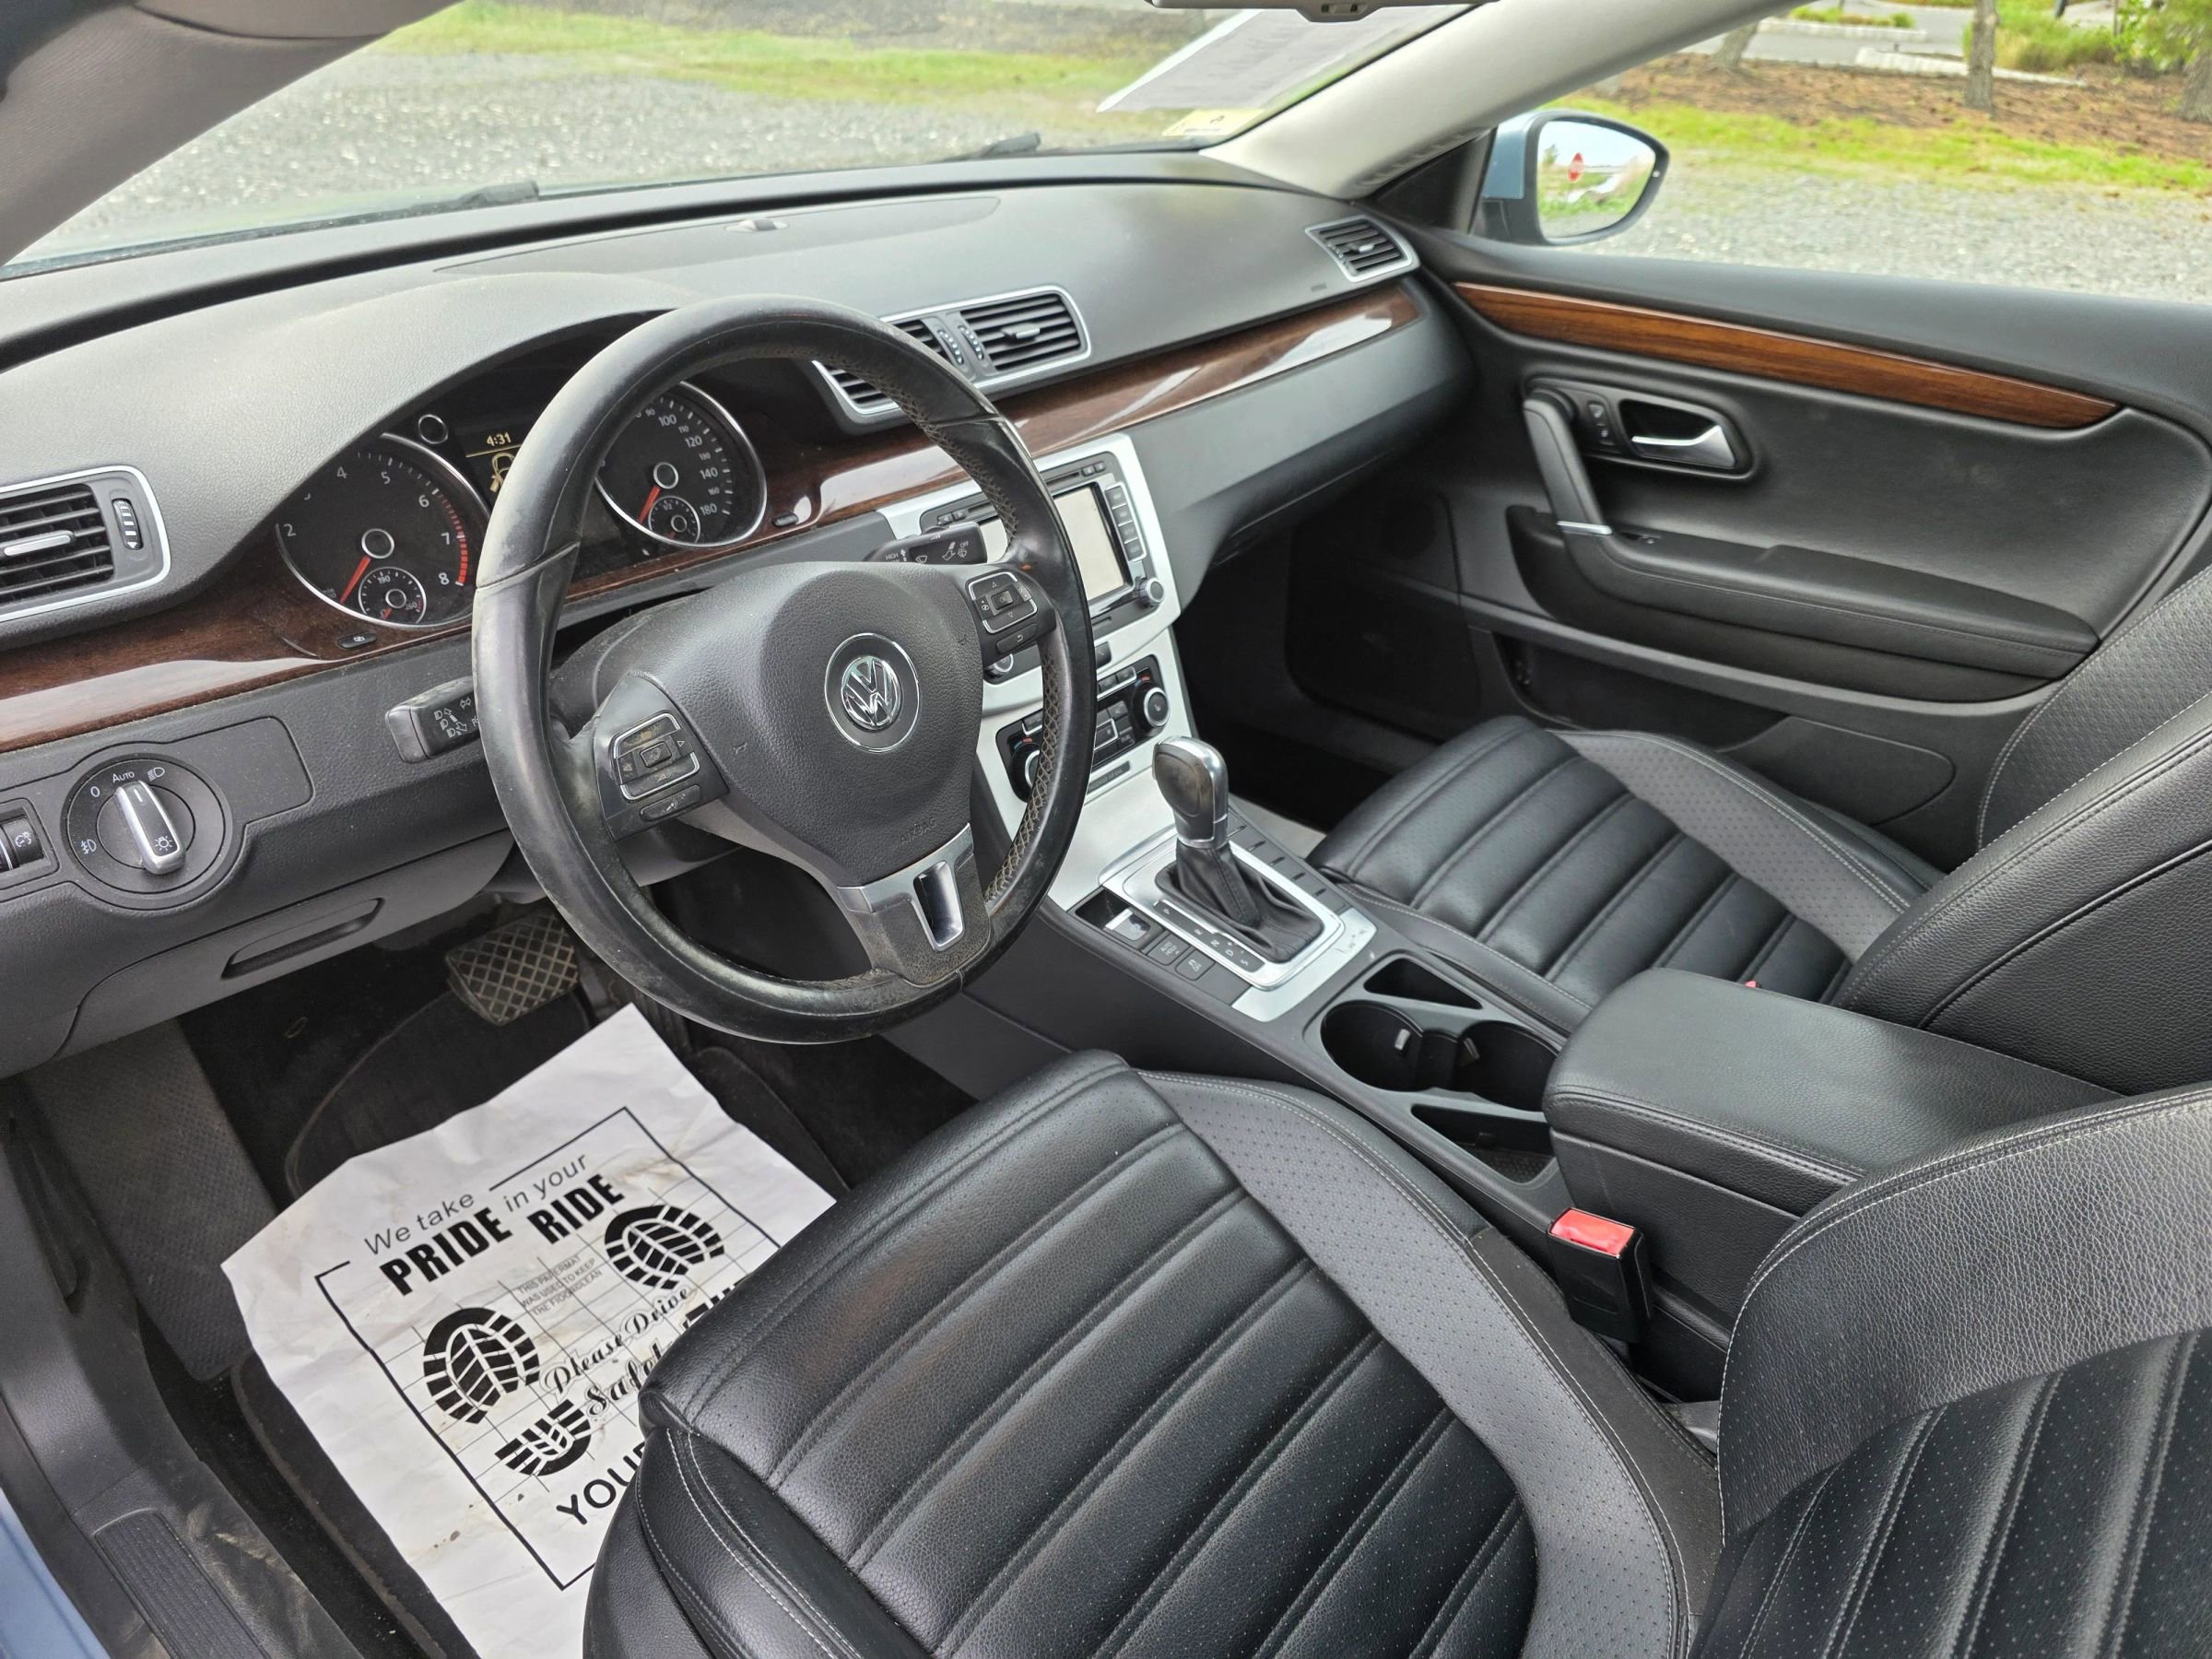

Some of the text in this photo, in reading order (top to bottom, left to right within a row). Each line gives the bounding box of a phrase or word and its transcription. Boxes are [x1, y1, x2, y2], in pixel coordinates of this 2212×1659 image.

[658, 414, 677, 427] 100
[487, 432, 512, 446] 4:31
[685, 434, 703, 448] 120
[336, 466, 347, 479] 4
[381, 472, 391, 485] 5
[700, 466, 719, 480] 140
[418, 495, 429, 508] 6
[700, 504, 718, 516] 180
[284, 524, 297, 536] 2
[441, 533, 452, 546] 7
[438, 571, 450, 585] 8
[364, 1154, 587, 1255] We take in your
[379, 1173, 626, 1297] PRIDE RIDE
[544, 1288, 689, 1394] Please Drive
